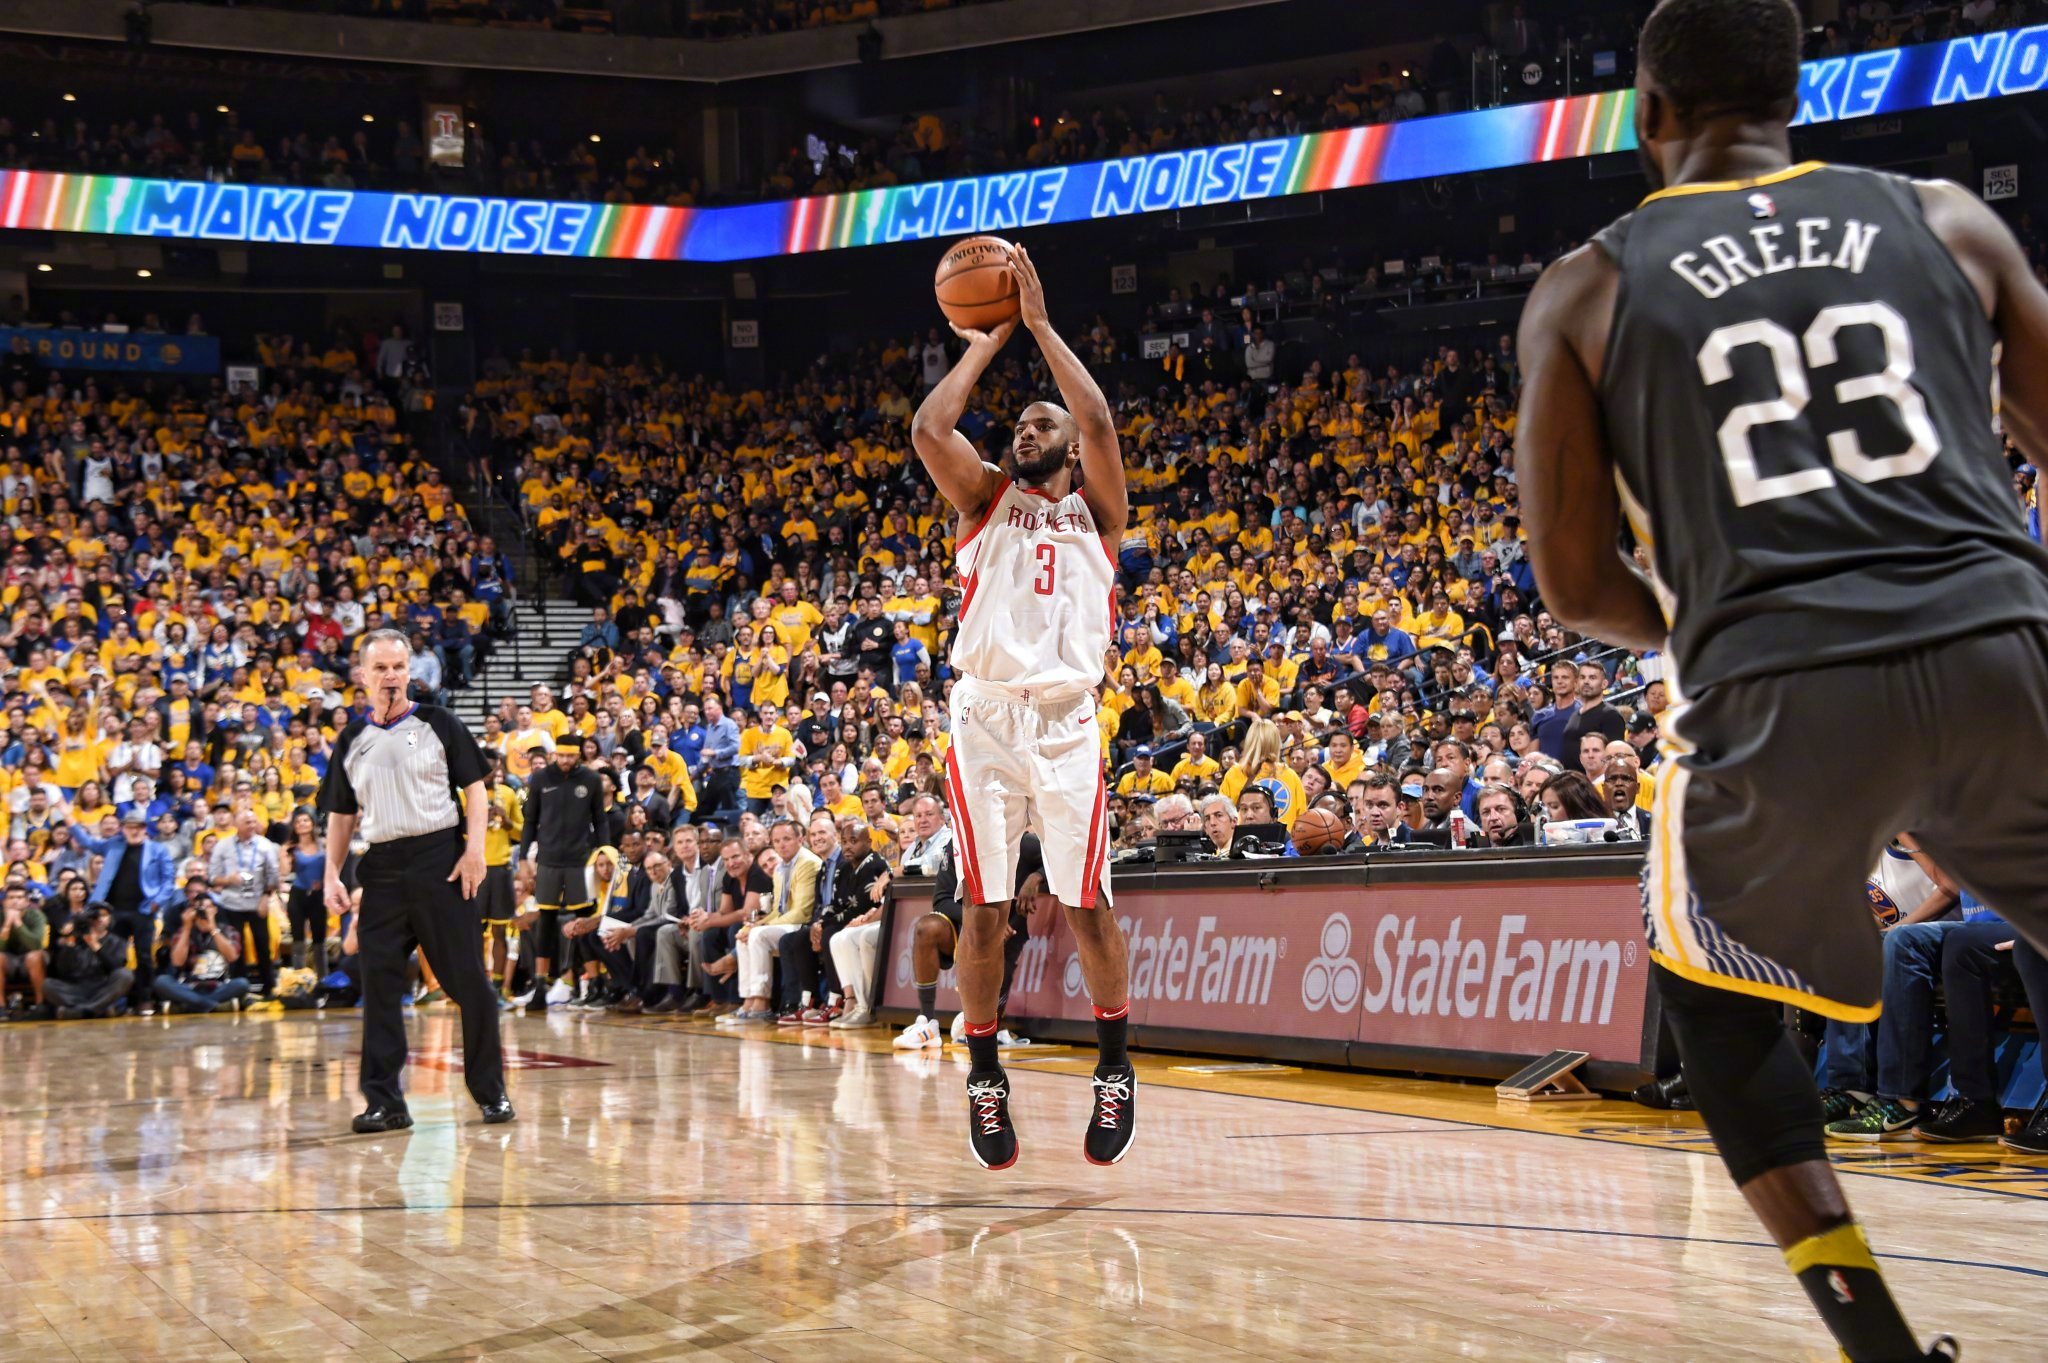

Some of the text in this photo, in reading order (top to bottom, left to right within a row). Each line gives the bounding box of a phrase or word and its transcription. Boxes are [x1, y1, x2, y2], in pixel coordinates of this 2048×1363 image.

[1522, 70, 1543, 80] TNT
[1787, 48, 1901, 127] KE
[1990, 169, 2011, 180] SEC
[885, 139, 1288, 243] MAKE NOISE
[1985, 179, 2016, 196] 125
[131, 180, 592, 256] MAKE NOISE
[945, 245, 1001, 265] PALDING
[1670, 217, 1881, 299] GREEN
[1114, 276, 1135, 290] 123
[735, 335, 757, 345] EXIT
[737, 325, 753, 335] NO
[25, 339, 142, 361] ROUND
[1149, 342, 1166, 351] SEC
[1697, 300, 1942, 507] 23
[1007, 504, 1088, 534] ROCKETS
[1034, 543, 1056, 596] 3
[1867, 888, 1884, 903] 35
[1364, 913, 1621, 1025] StateFarm
